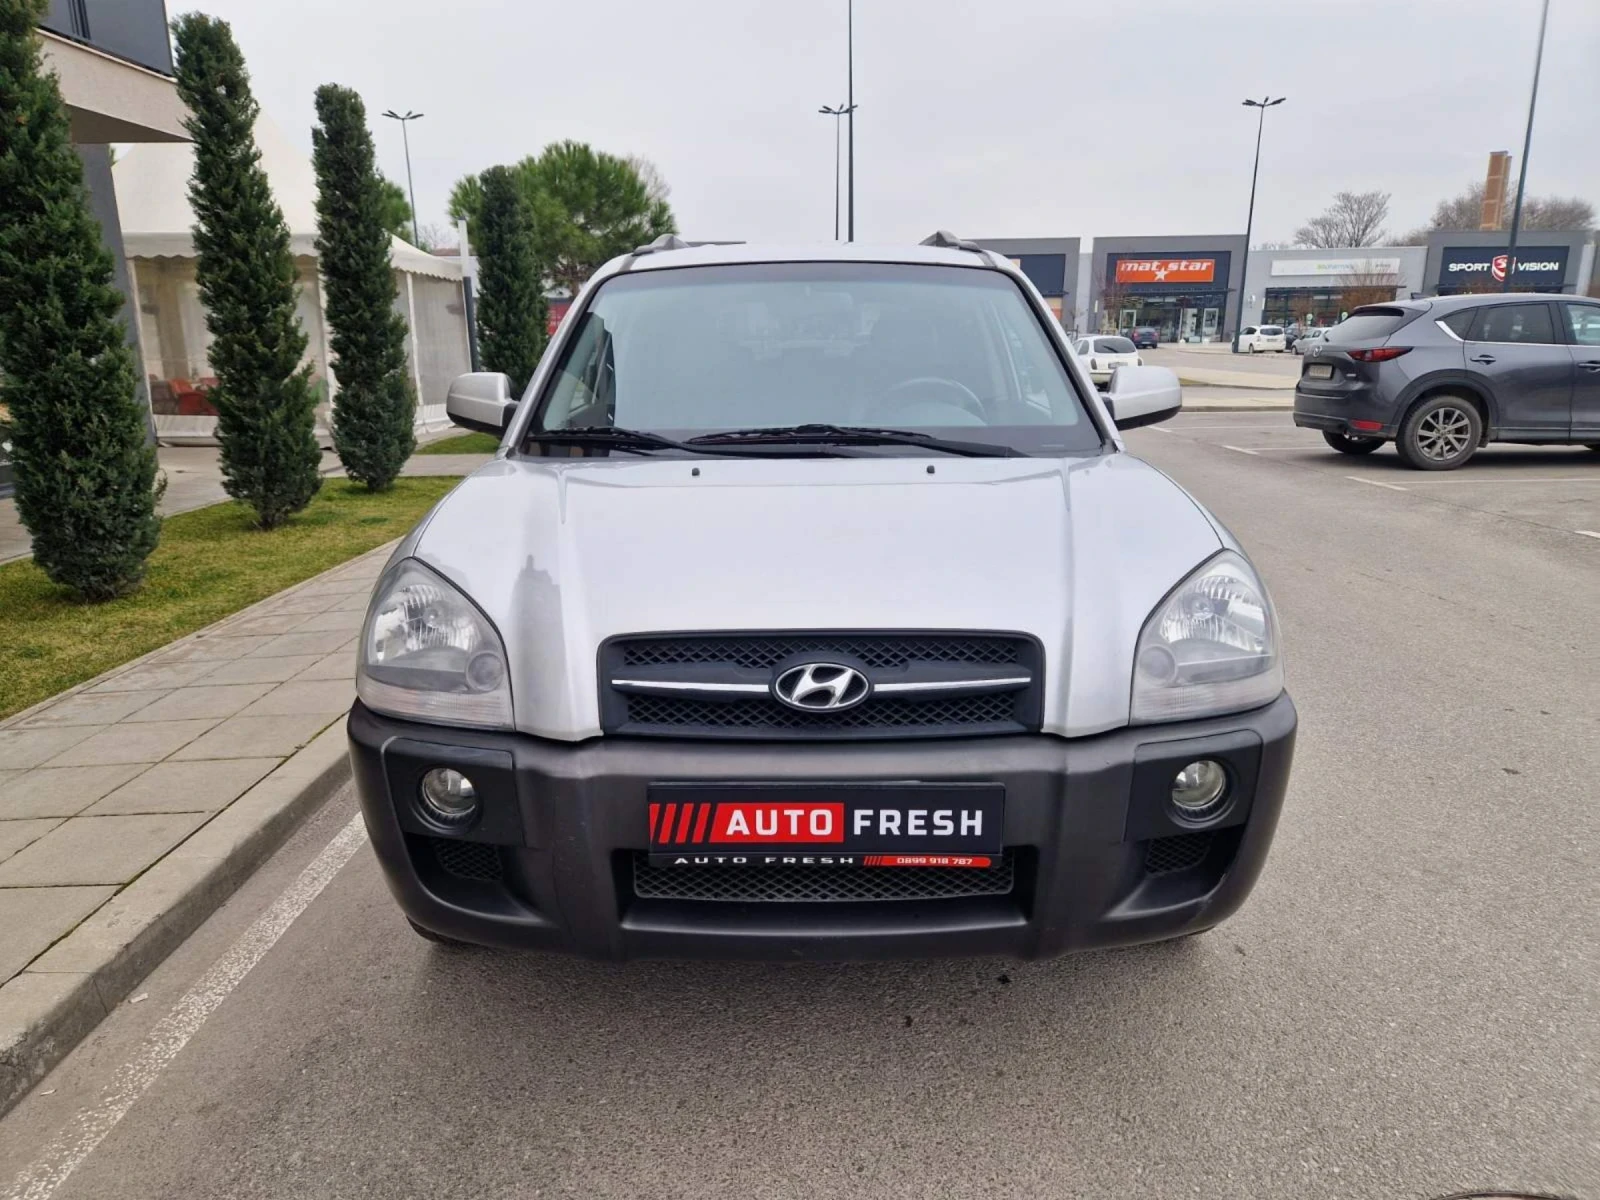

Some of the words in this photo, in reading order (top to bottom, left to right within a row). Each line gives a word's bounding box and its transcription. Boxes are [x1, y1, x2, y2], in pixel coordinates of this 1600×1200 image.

[1121, 261, 1161, 271] mat
[1167, 260, 1212, 271] star
[1448, 263, 1491, 271] SPORT
[1517, 262, 1559, 271] VISION
[725, 809, 833, 836] AUTO
[853, 809, 983, 836] FRESH
[897, 857, 928, 865] 0899
[930, 857, 949, 865] 918
[953, 858, 973, 866] 787
